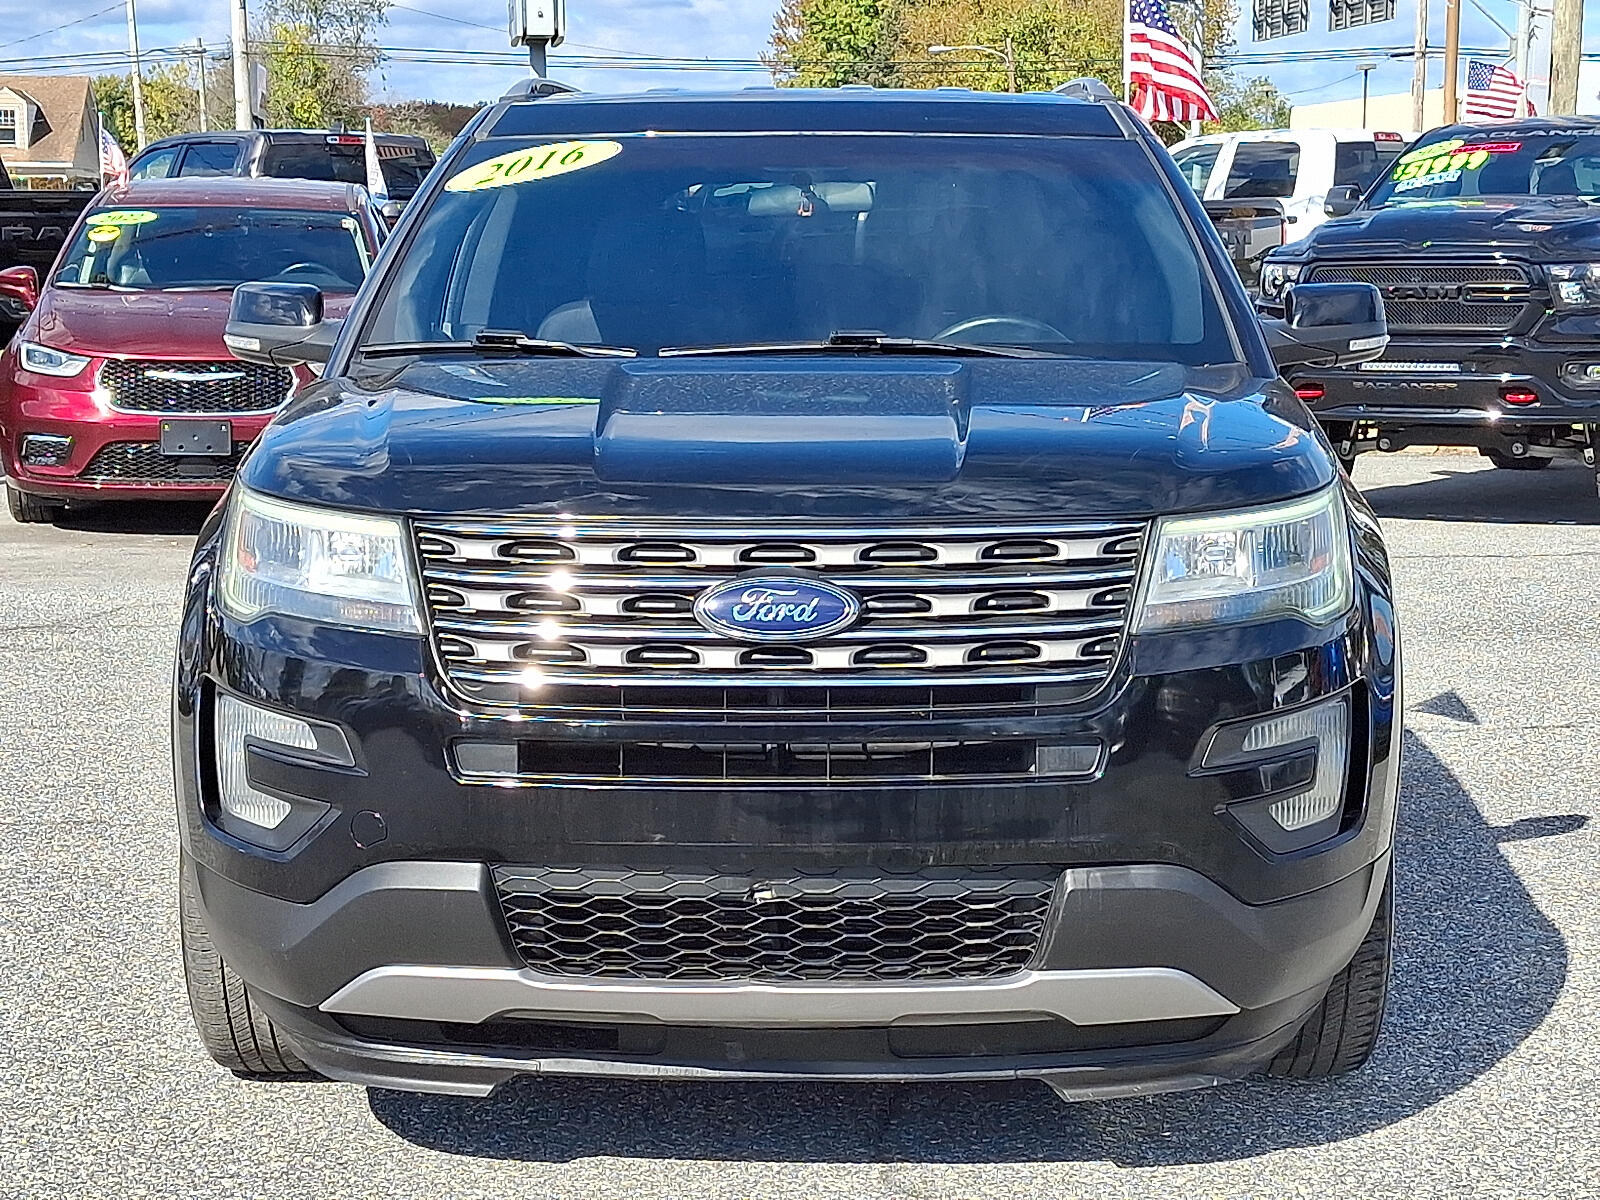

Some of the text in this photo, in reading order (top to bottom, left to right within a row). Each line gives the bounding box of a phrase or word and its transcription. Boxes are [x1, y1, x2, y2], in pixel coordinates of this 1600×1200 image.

[474, 144, 590, 185] 2016
[1353, 381, 1458, 390] BADLANDER
[731, 587, 820, 622] Ford
